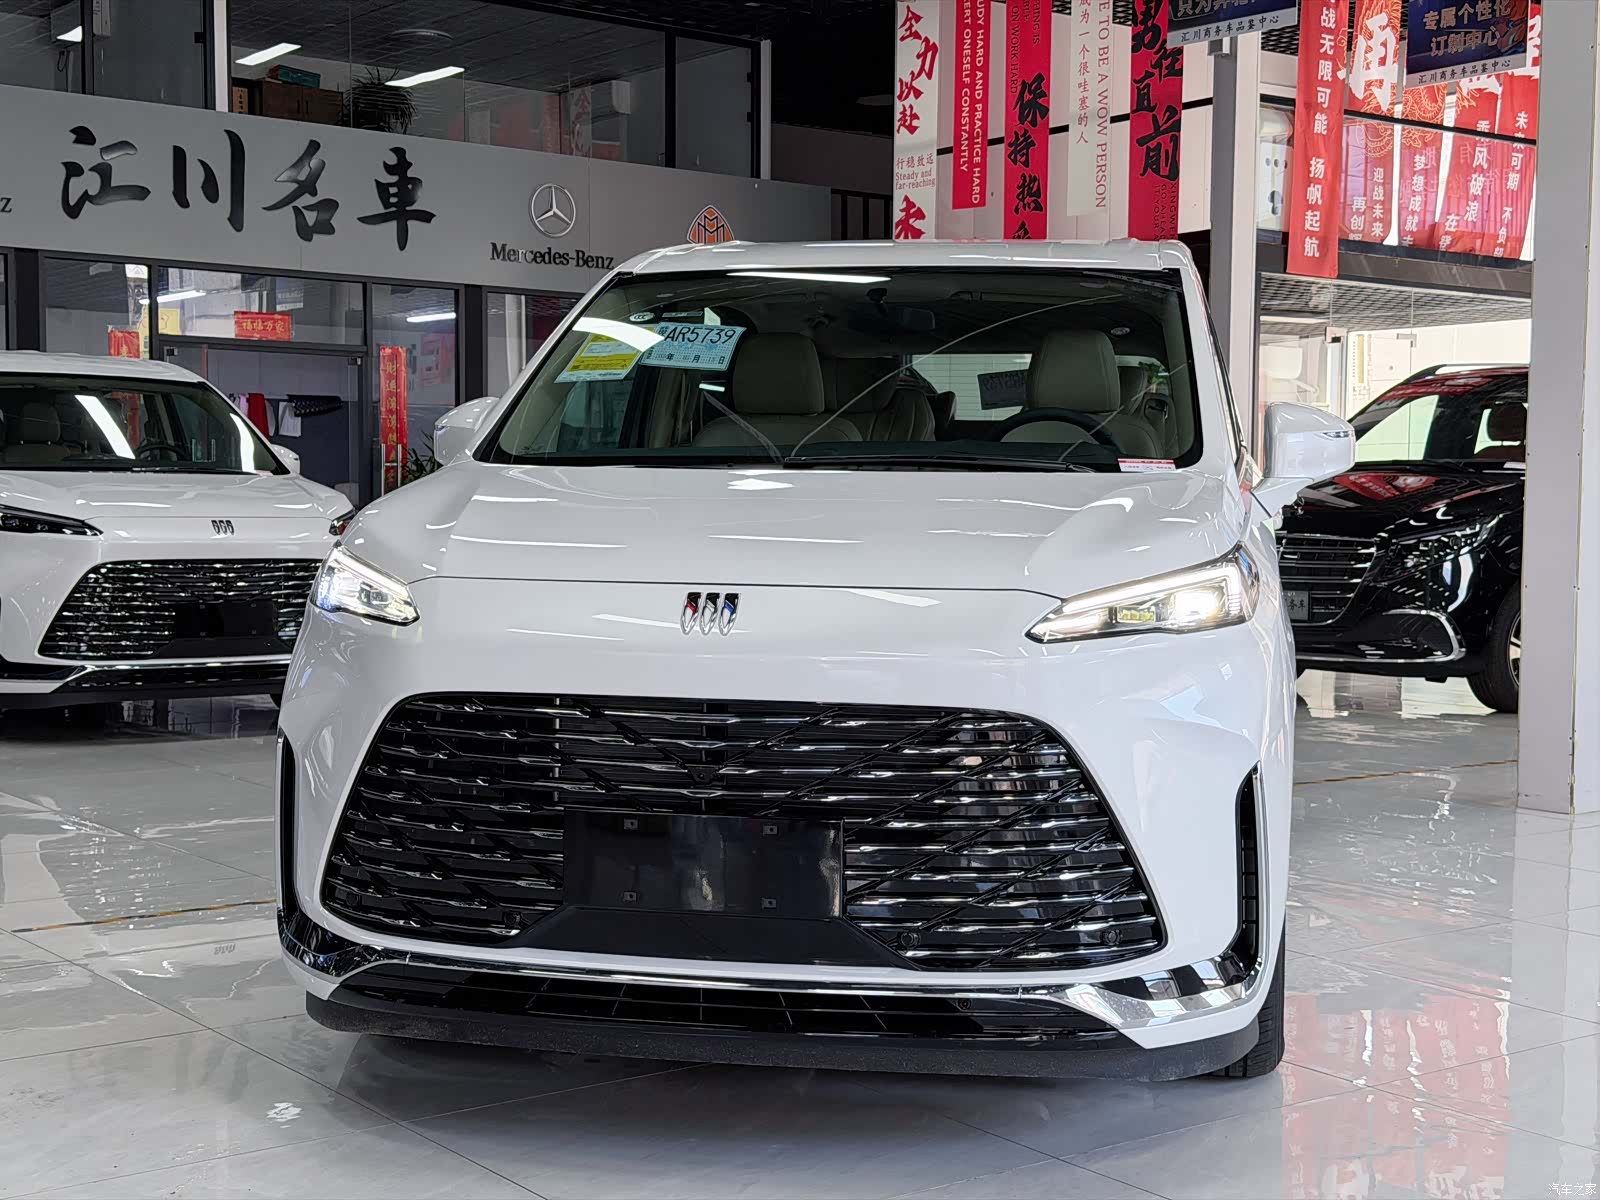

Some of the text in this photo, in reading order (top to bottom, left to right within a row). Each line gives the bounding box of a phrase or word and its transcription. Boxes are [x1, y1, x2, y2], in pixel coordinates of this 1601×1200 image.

[1010, 25, 1020, 60] WORK
[1098, 16, 1110, 40] TO
[1181, 15, 1280, 42] 汇川商务车品鉴中心
[962, 29, 972, 85] ONESELF
[975, 29, 985, 67] HARD
[1097, 46, 1109, 68] BE
[897, 4, 939, 135] 全力以赴
[974, 71, 984, 100] AND
[1010, 63, 1019, 94] HARD
[1097, 73, 1109, 84] A
[1418, 59, 1512, 84] 汇川商务车品鉴中心
[1096, 89, 1109, 136] WOW
[960, 88, 971, 172] CONSTANTLY
[973, 103, 983, 164] PRACTICE
[895, 168, 932, 182] Steady and
[896, 153, 934, 169] 行稳致远
[1095, 142, 1108, 208] PERSON
[895, 178, 936, 190] far-reaching
[971, 169, 982, 204] HARD
[1304, 156, 1326, 258] 扬帆起航
[1371, 167, 1385, 237] 迎战未来
[490, 241, 615, 271] Mercedes-Benz
